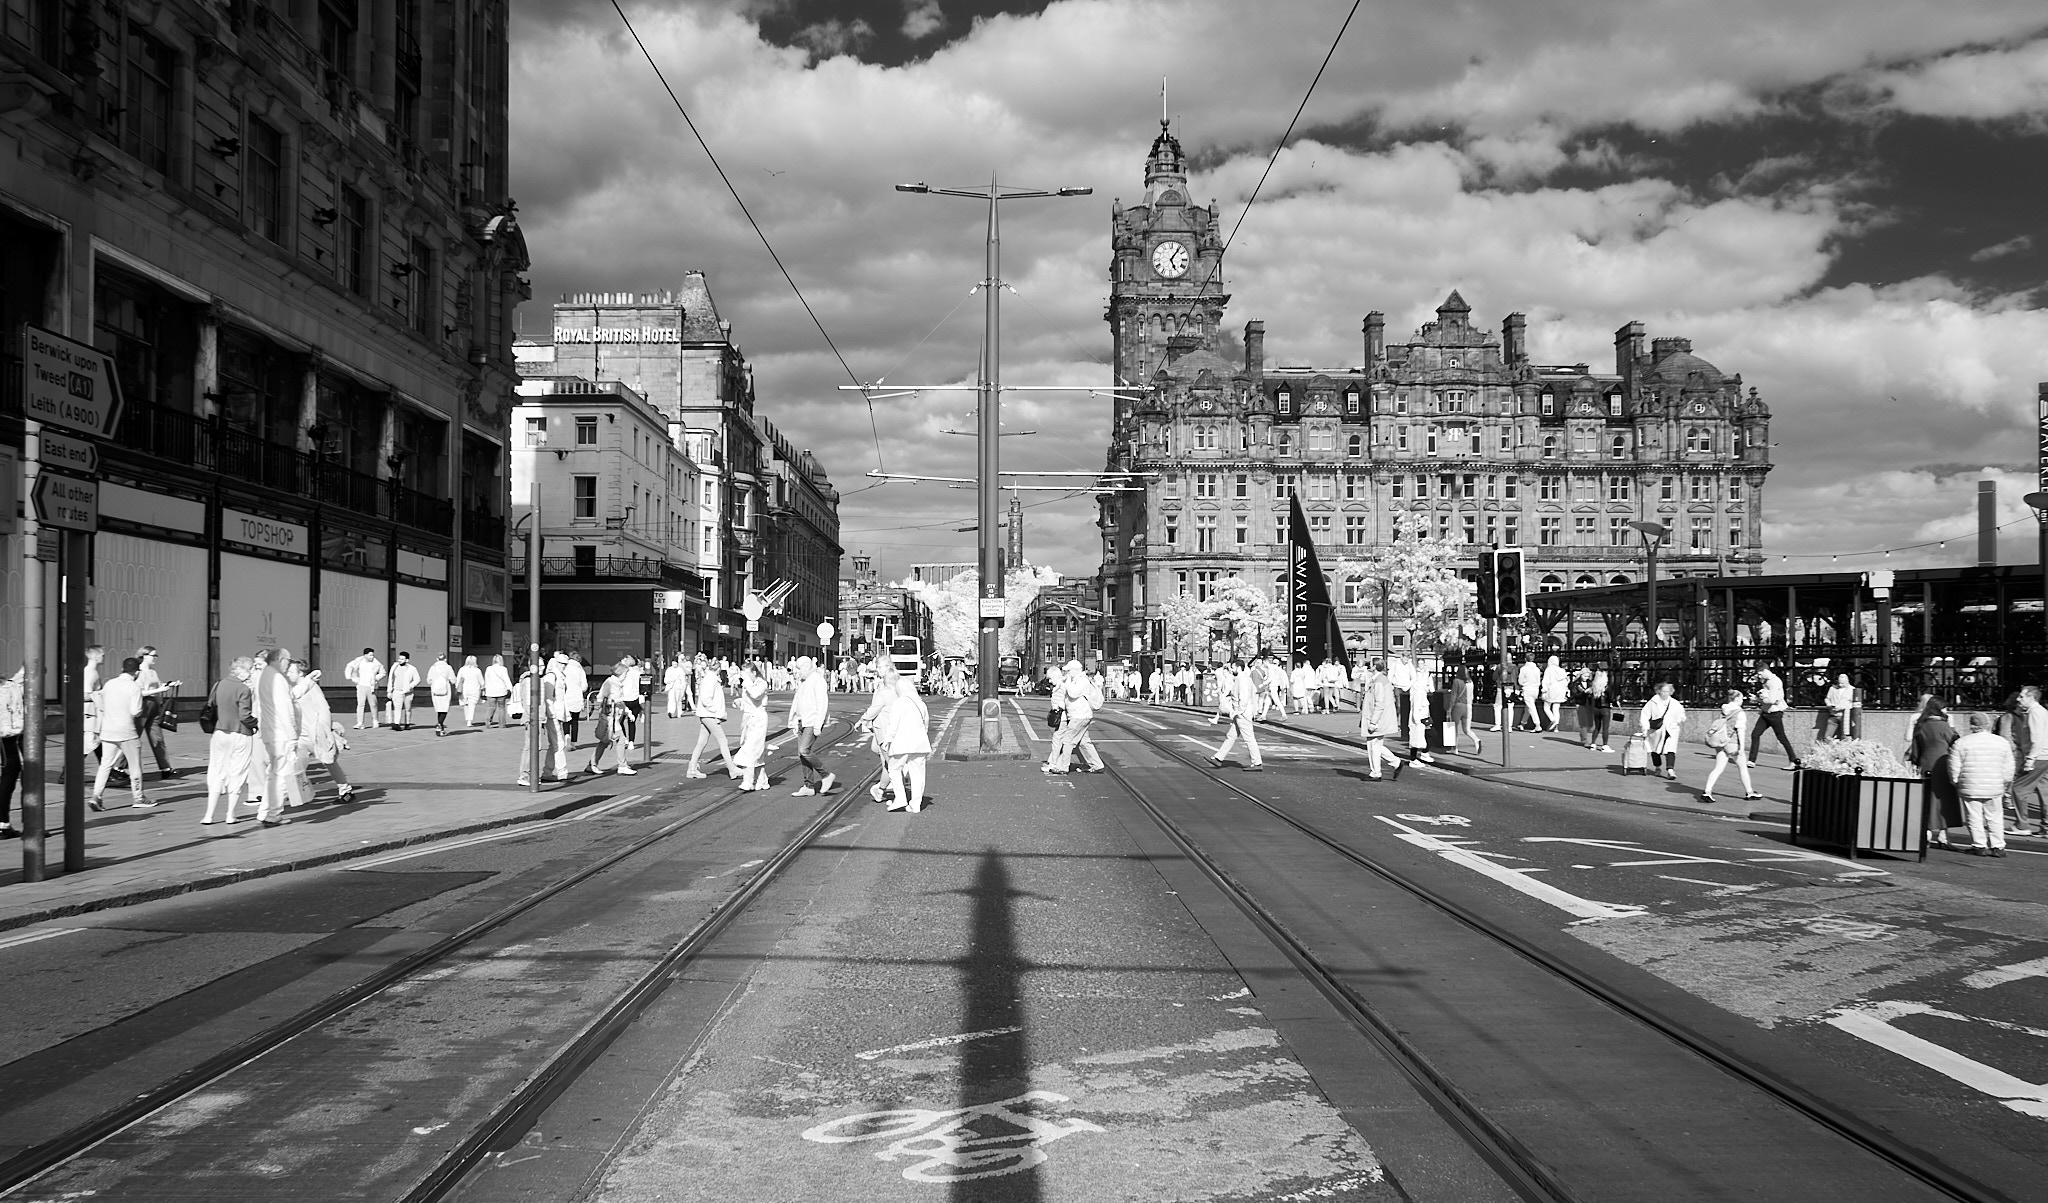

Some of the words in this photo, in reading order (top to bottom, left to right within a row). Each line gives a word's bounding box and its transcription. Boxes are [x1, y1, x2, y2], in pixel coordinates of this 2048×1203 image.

[554, 326, 591, 343] ROYAL
[592, 326, 639, 343] BRITISH
[642, 325, 680, 343] HOTEL
[31, 334, 72, 364] Berwick
[74, 355, 98, 373] upon
[34, 362, 67, 388] Tweed
[70, 372, 93, 400] (A1)
[31, 393, 57, 415] Leith
[60, 400, 100, 429] (A900)
[44, 438, 67, 459] East
[69, 448, 87, 463] end
[52, 481, 66, 498] All
[68, 486, 93, 504] other
[240, 518, 294, 547] TOPSHOP
[1295, 560, 1307, 655] WAVERLEY
